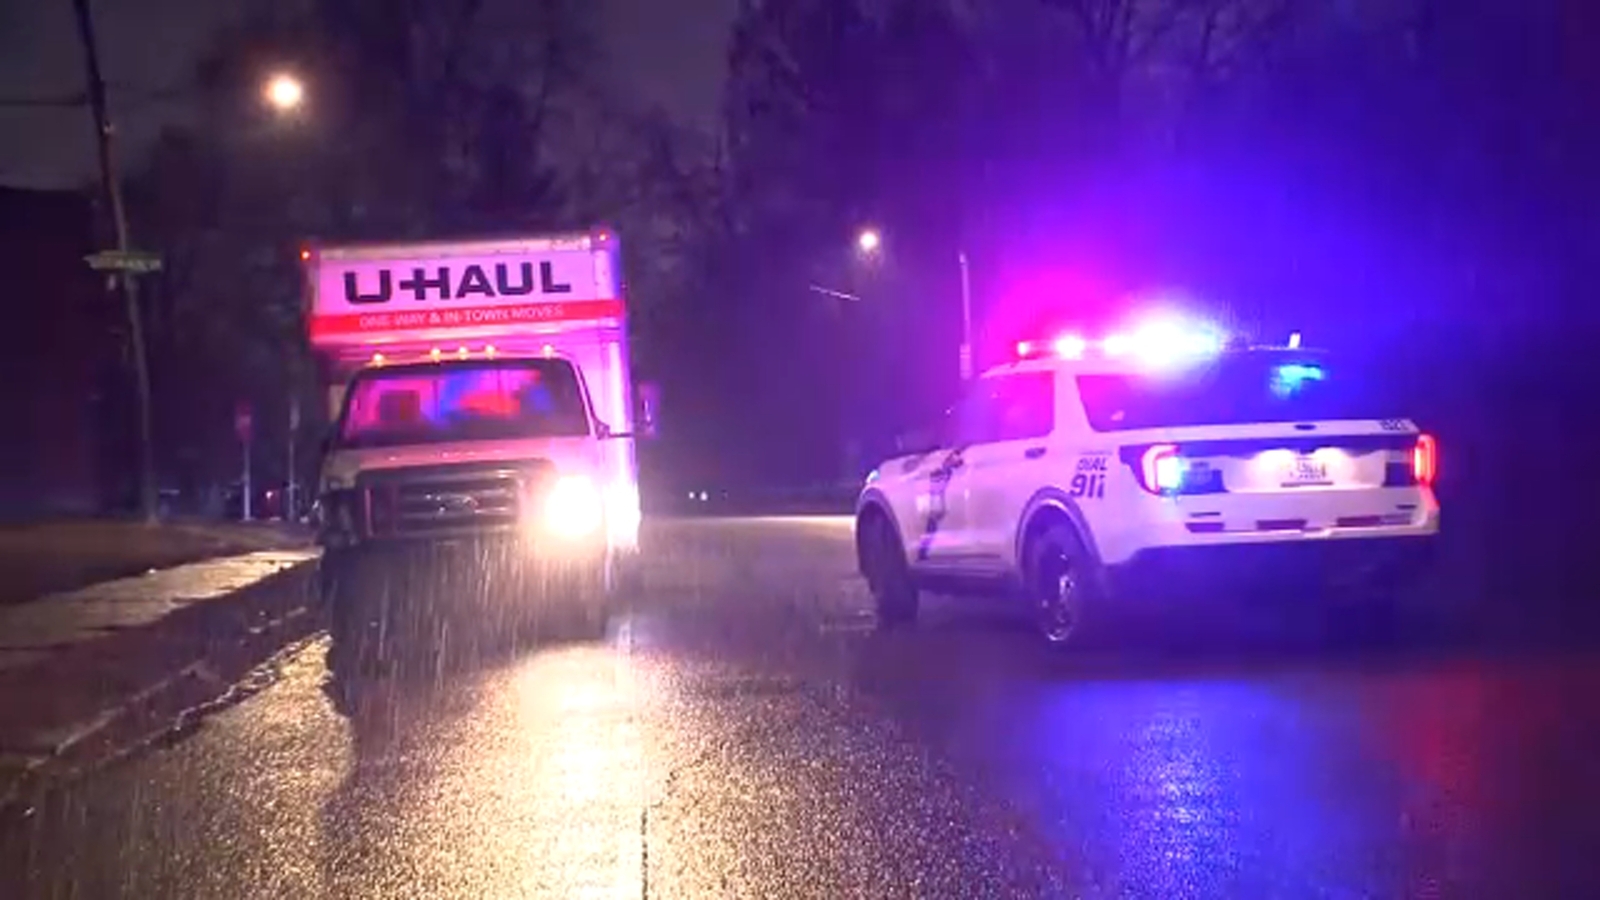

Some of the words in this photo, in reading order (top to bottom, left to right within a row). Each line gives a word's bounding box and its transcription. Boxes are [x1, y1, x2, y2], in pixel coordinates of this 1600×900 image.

[344, 261, 572, 304] U-HAUL
[429, 311, 441, 324] &
[511, 304, 564, 319] MOVES
[1076, 457, 1107, 471] DIAL
[1069, 473, 1106, 499] 911
